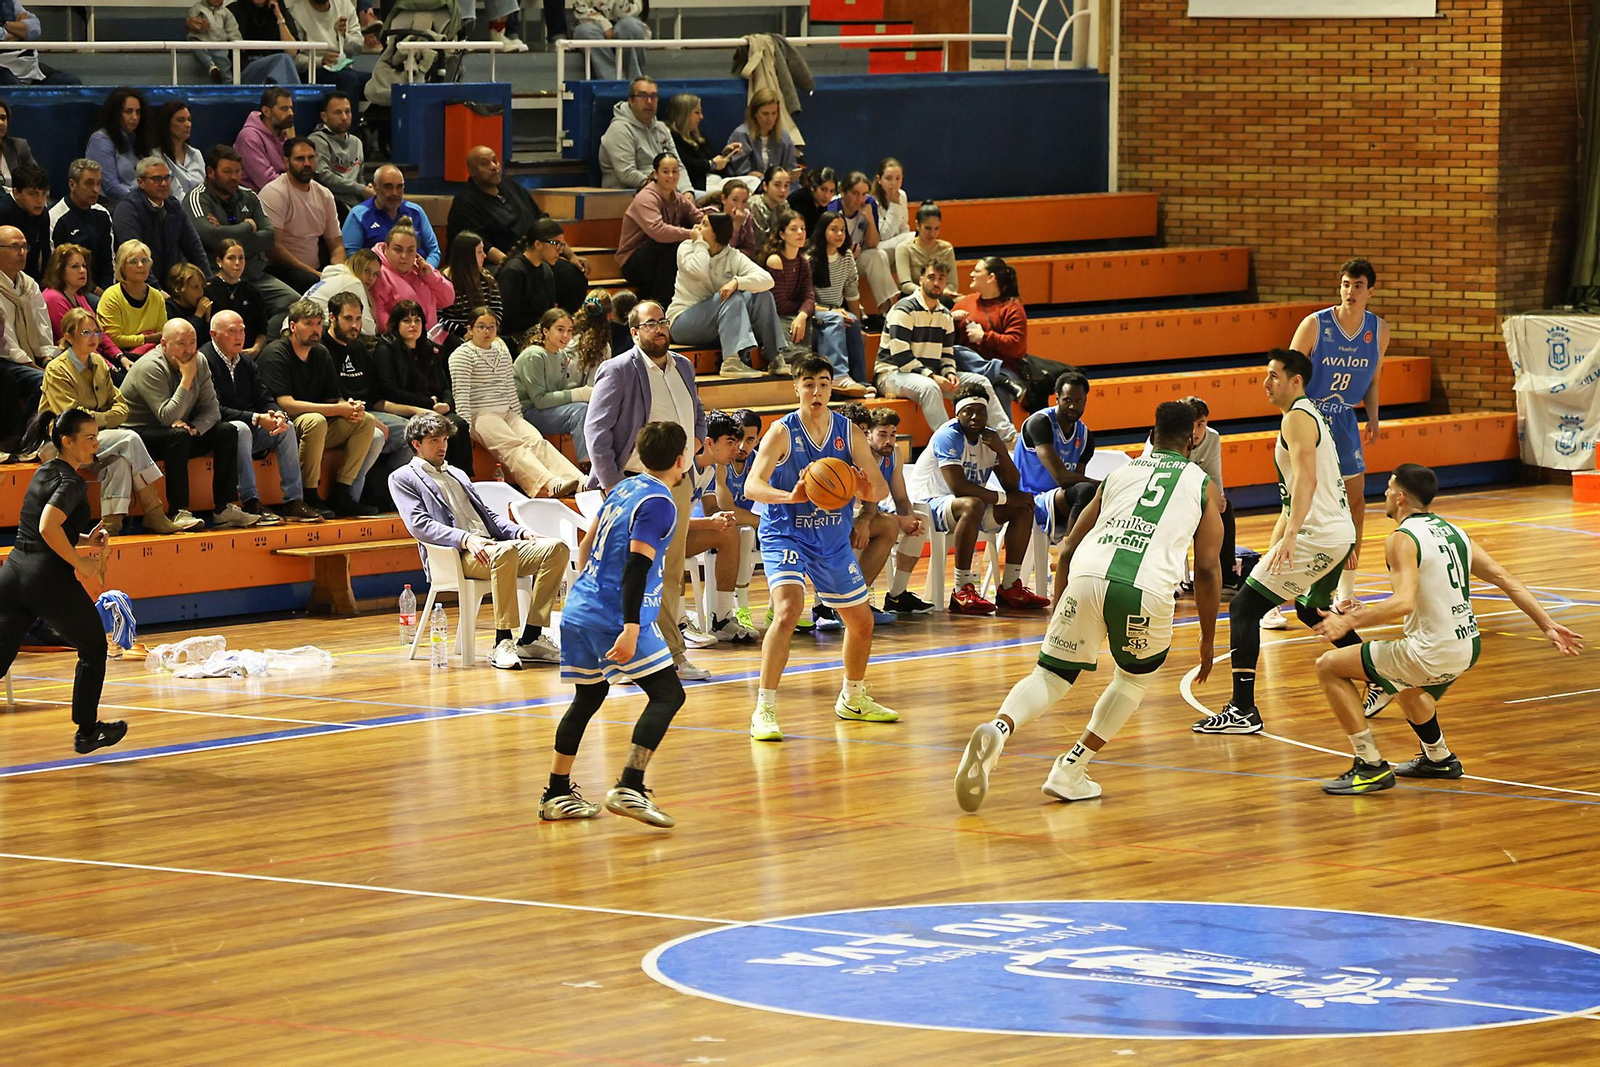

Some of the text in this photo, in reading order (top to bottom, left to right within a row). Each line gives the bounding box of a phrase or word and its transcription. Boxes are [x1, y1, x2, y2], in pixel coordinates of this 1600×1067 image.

[1330, 372, 1351, 391] 28
[1140, 472, 1172, 507] 5
[200, 541, 213, 552] 20
[254, 536, 267, 546] 22
[307, 531, 320, 542] 24
[360, 527, 372, 537] 26
